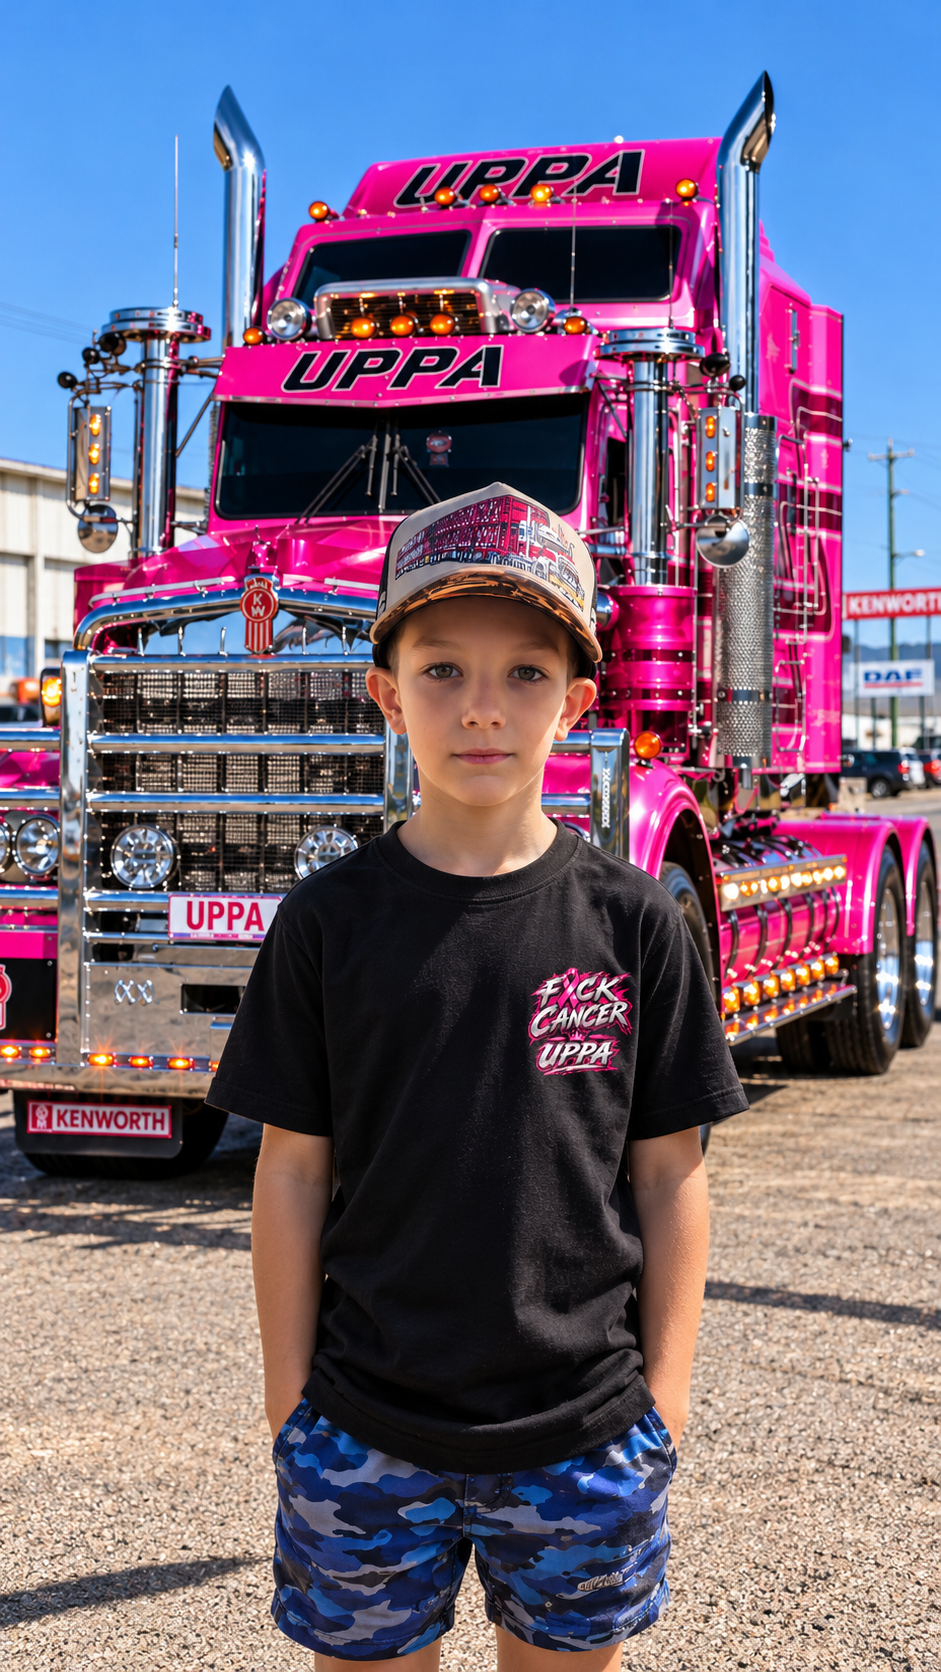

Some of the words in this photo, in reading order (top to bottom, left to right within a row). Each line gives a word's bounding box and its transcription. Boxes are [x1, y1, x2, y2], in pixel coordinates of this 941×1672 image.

[393, 150, 645, 208] UPPA
[280, 344, 504, 393] UPPA
[186, 900, 265, 932] UPPA
[530, 1001, 629, 1037] CANCER
[538, 1041, 613, 1069] UPPA
[56, 1108, 165, 1132] KENWORTH
